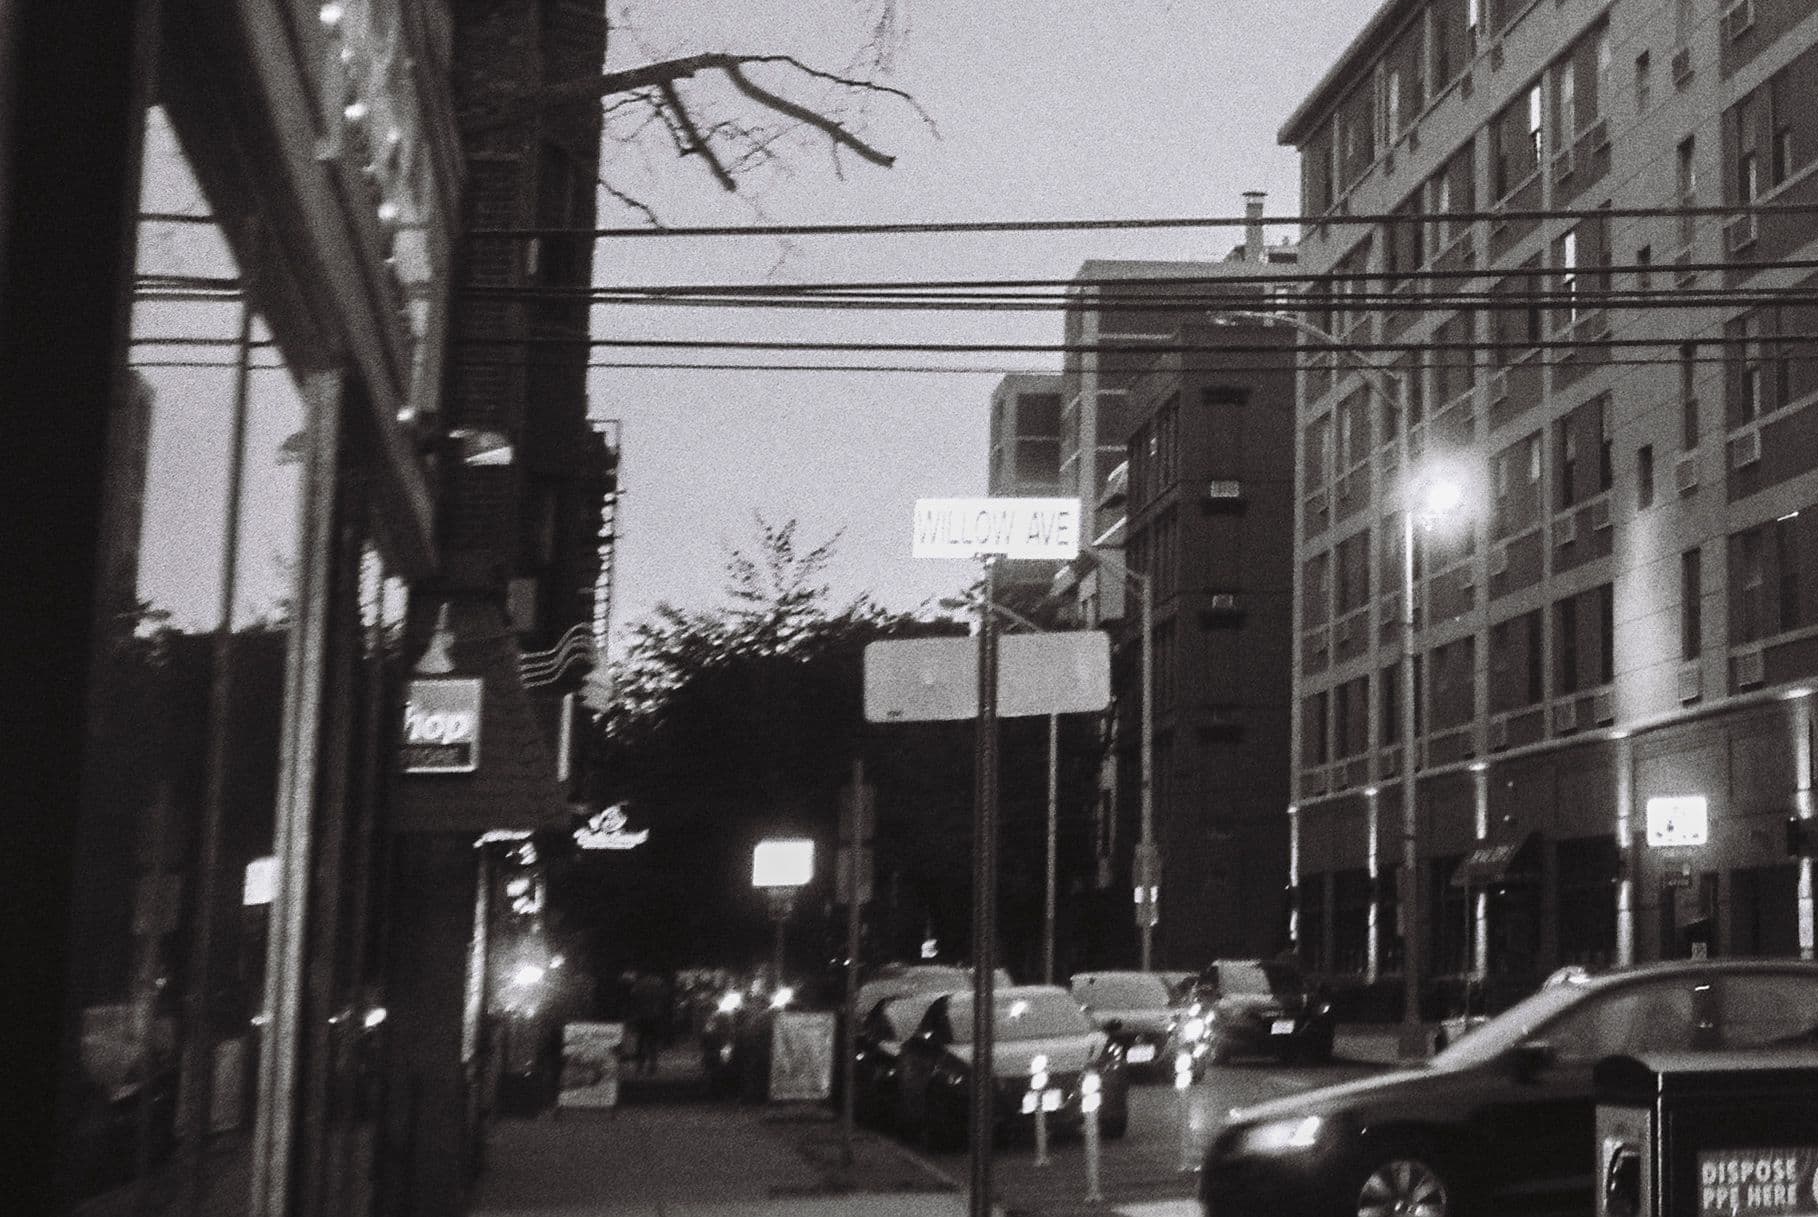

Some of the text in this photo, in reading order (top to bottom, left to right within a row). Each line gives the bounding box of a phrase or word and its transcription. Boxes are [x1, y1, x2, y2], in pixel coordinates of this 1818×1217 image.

[918, 510, 1070, 546] WILLOW AVE
[404, 701, 471, 745] hop
[1702, 1158, 1797, 1185] DISPOSE
[1702, 1183, 1797, 1210] PPE HERE
